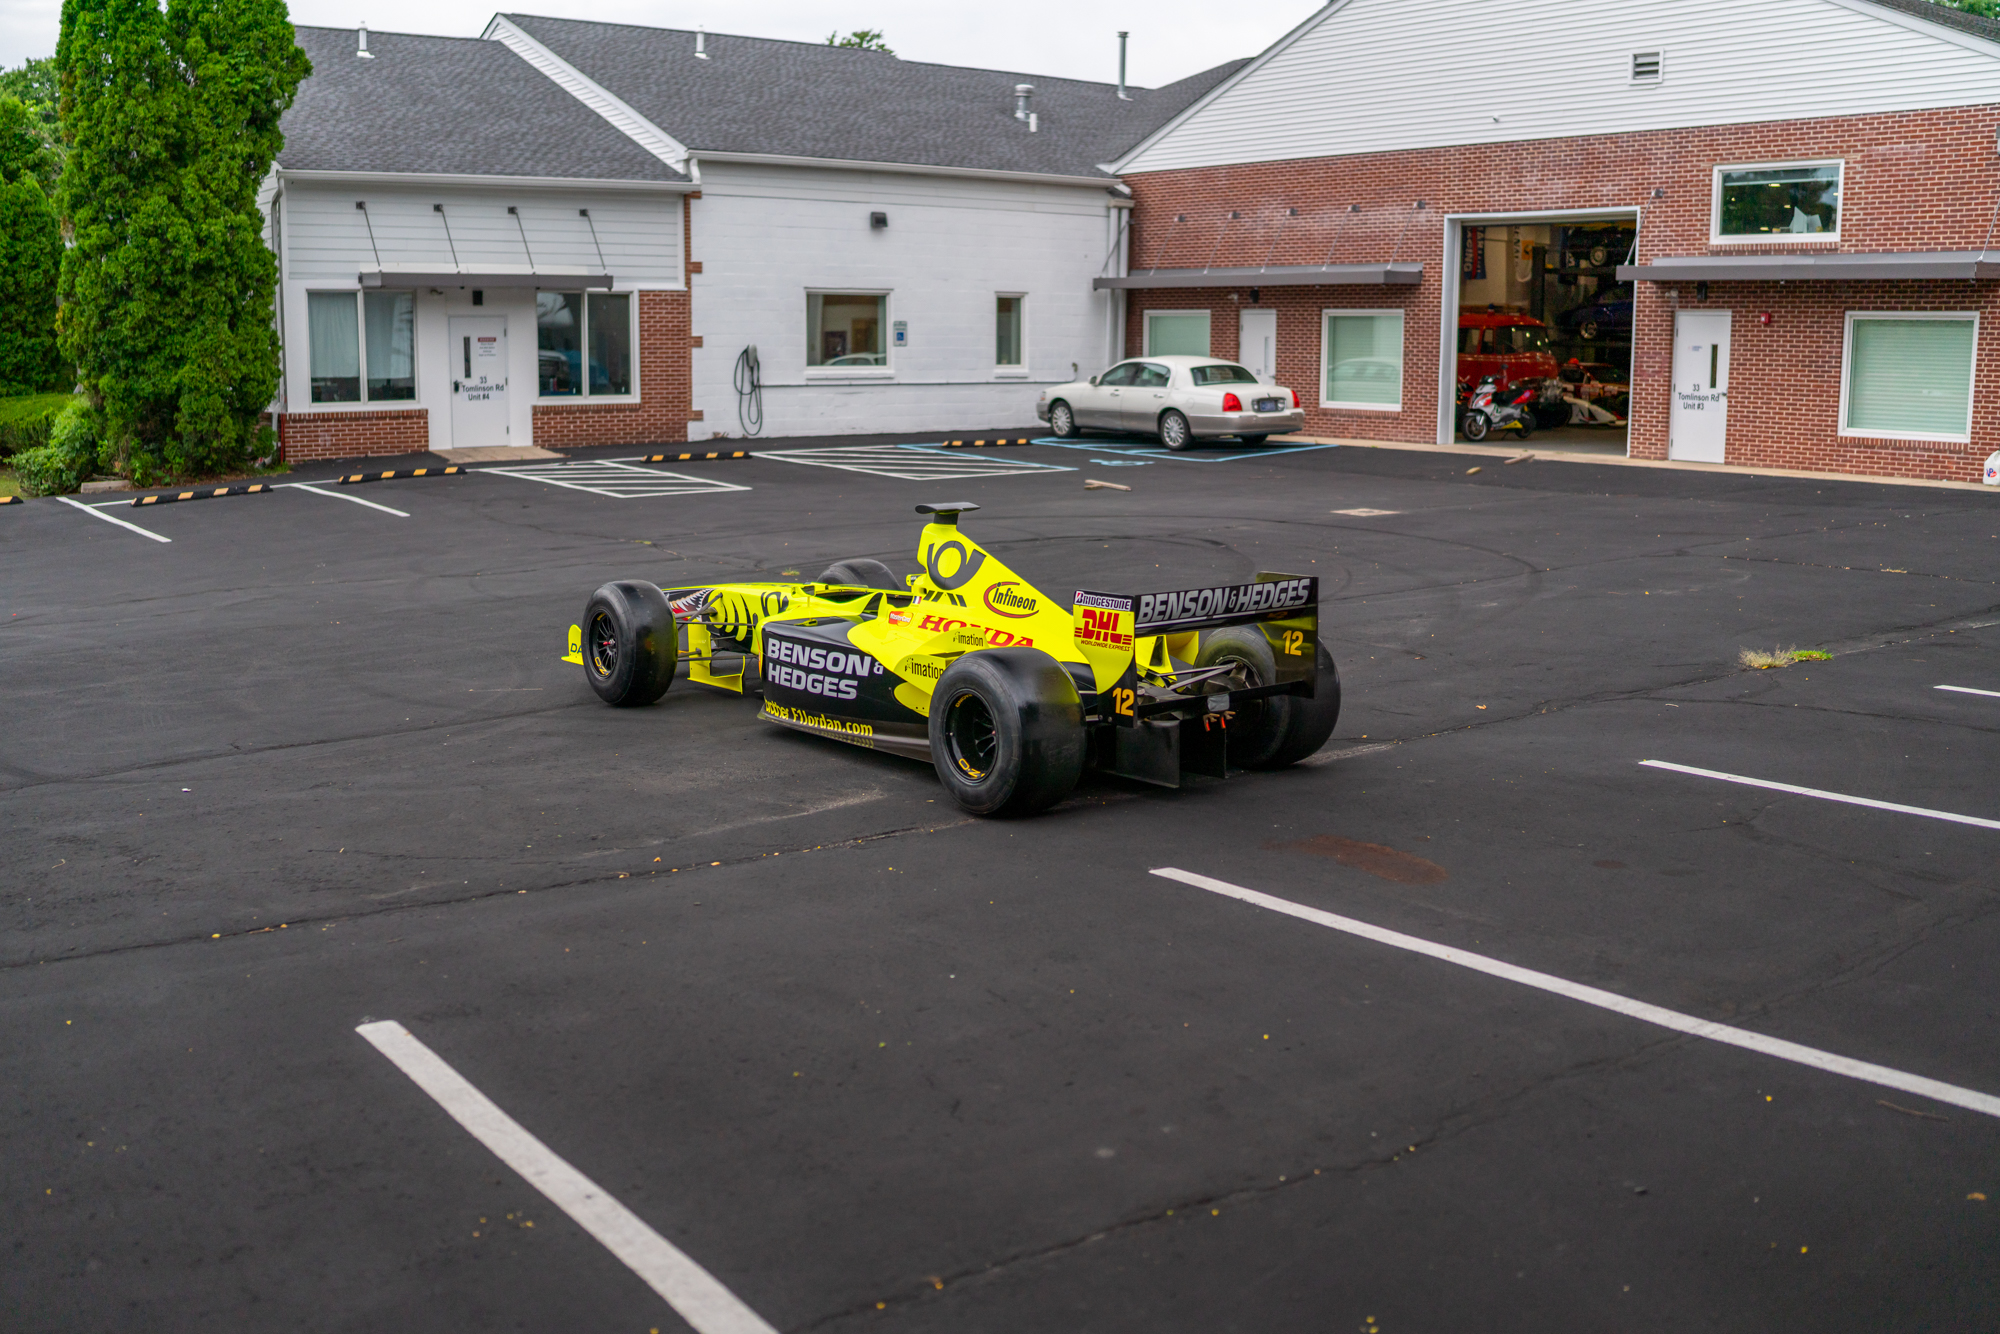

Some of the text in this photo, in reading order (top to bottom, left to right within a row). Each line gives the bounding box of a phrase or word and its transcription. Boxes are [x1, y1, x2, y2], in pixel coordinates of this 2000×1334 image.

[462, 383, 505, 393] Tomlinson Rd
[480, 376, 488, 385] 33
[1692, 383, 1700, 392] 33
[468, 393, 481, 401] Unit
[1678, 392, 1720, 402] Tomlinson Rd
[1683, 402, 1696, 410] Unit
[992, 581, 1036, 611] Infineon
[1076, 592, 1131, 610] BRIDGESTONE
[1135, 587, 1230, 624] BENSON
[1233, 578, 1311, 613] HEDGES
[917, 614, 1034, 648] HODA
[1082, 608, 1123, 644] DHL
[957, 632, 984, 647] imation
[1081, 639, 1107, 649] WORLDWIDE
[1282, 630, 1305, 656] 12
[767, 637, 872, 677] BENSON
[767, 662, 858, 700] HEDGES
[1112, 687, 1135, 717] 12
[791, 707, 874, 737] F1Jordan.com
